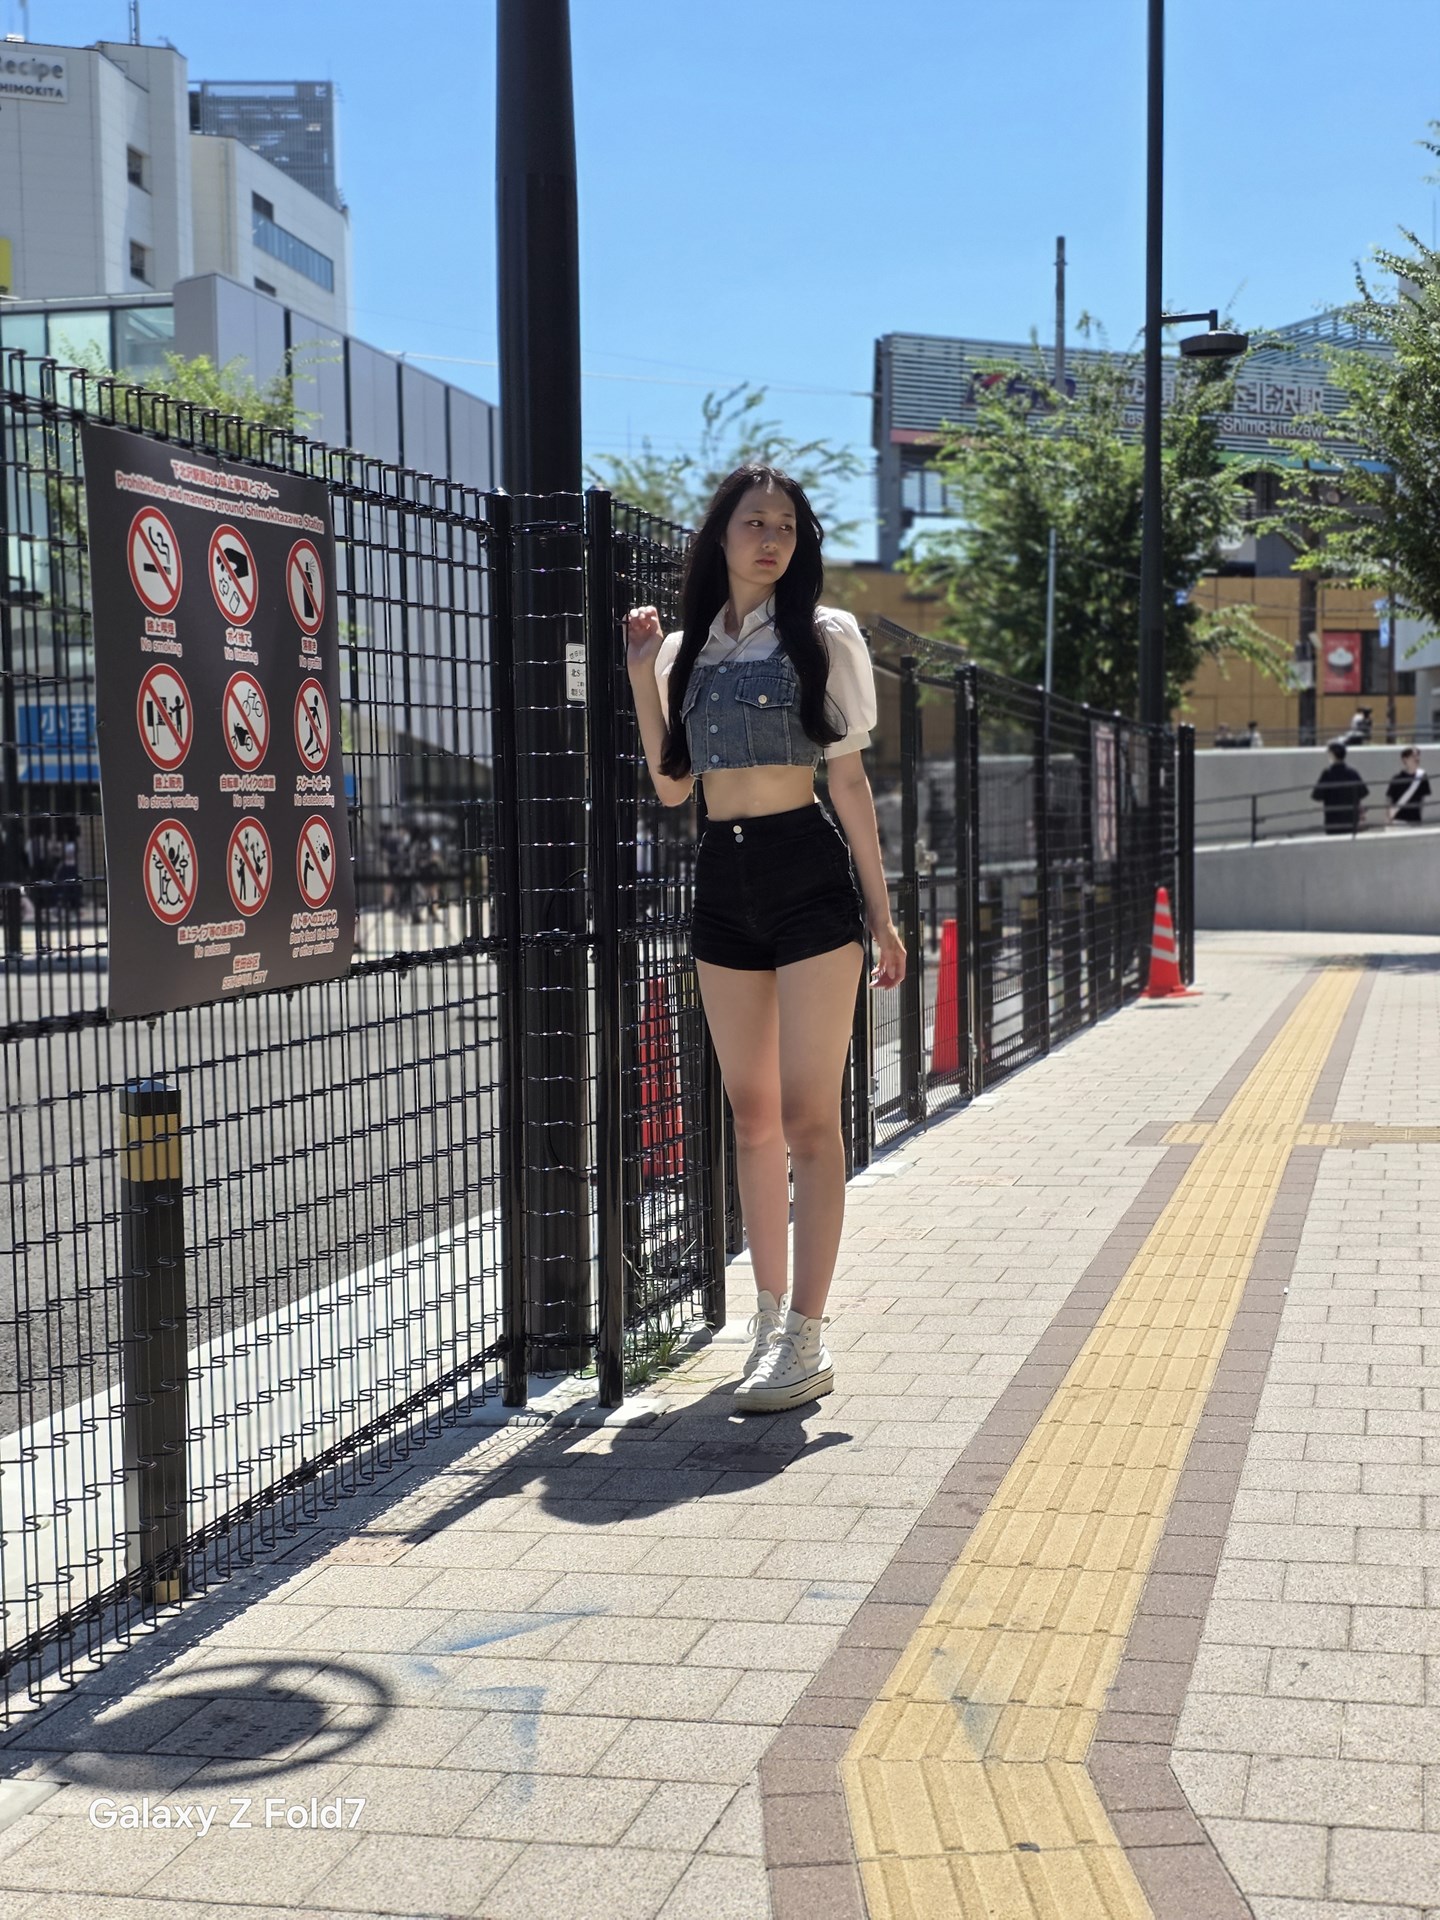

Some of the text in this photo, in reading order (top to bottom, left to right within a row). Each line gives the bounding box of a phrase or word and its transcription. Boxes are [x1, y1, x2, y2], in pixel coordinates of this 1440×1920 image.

[0, 57, 63, 82] ecipe
[115, 470, 325, 535] Prohibitions and manners around Shimokitazawa Station
[140, 637, 182, 658] No smoking
[224, 646, 235, 661] No
[299, 654, 307, 668] No
[137, 793, 199, 811] No street vending
[232, 793, 265, 810] No parking
[293, 793, 302, 807] No
[194, 945, 204, 959] No
